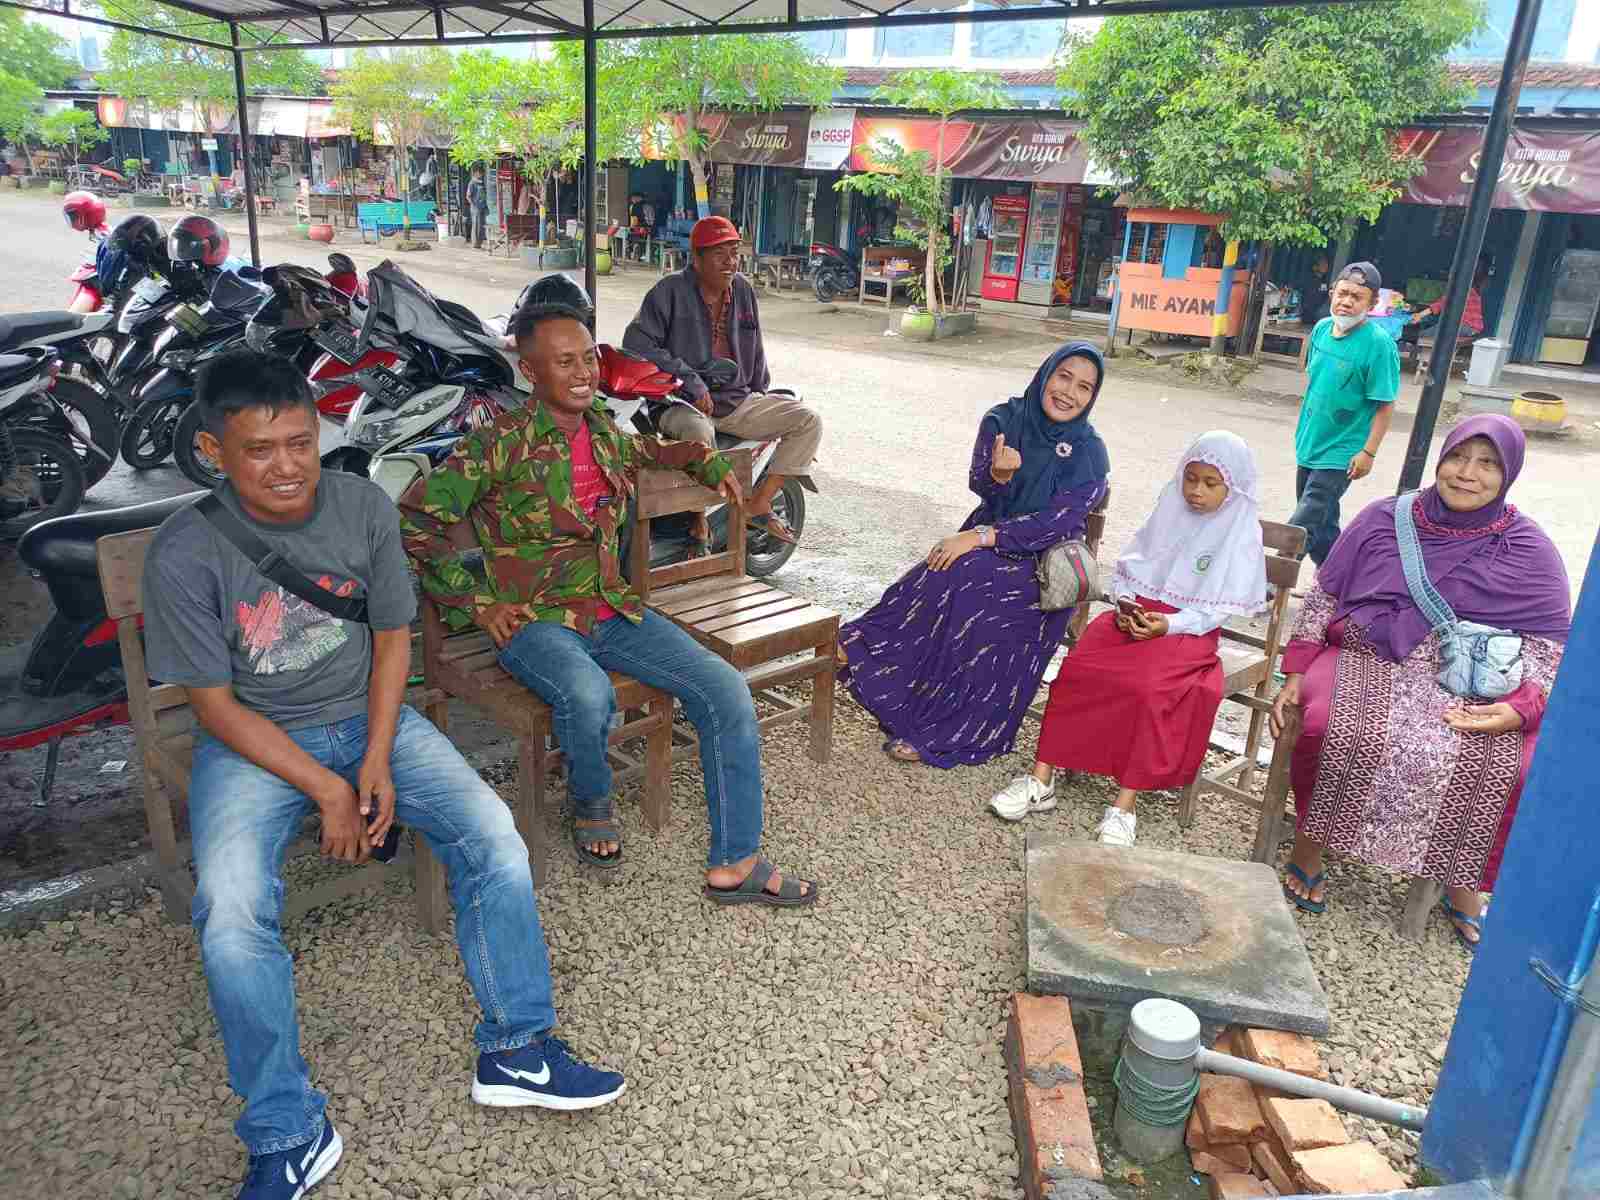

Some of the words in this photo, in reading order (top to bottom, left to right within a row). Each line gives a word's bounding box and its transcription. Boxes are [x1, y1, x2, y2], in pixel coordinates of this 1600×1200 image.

[822, 129, 852, 143] GGSP
[1000, 135, 1068, 174] Surya
[1130, 292, 1158, 311] MIE
[1163, 297, 1216, 316] AYAM
